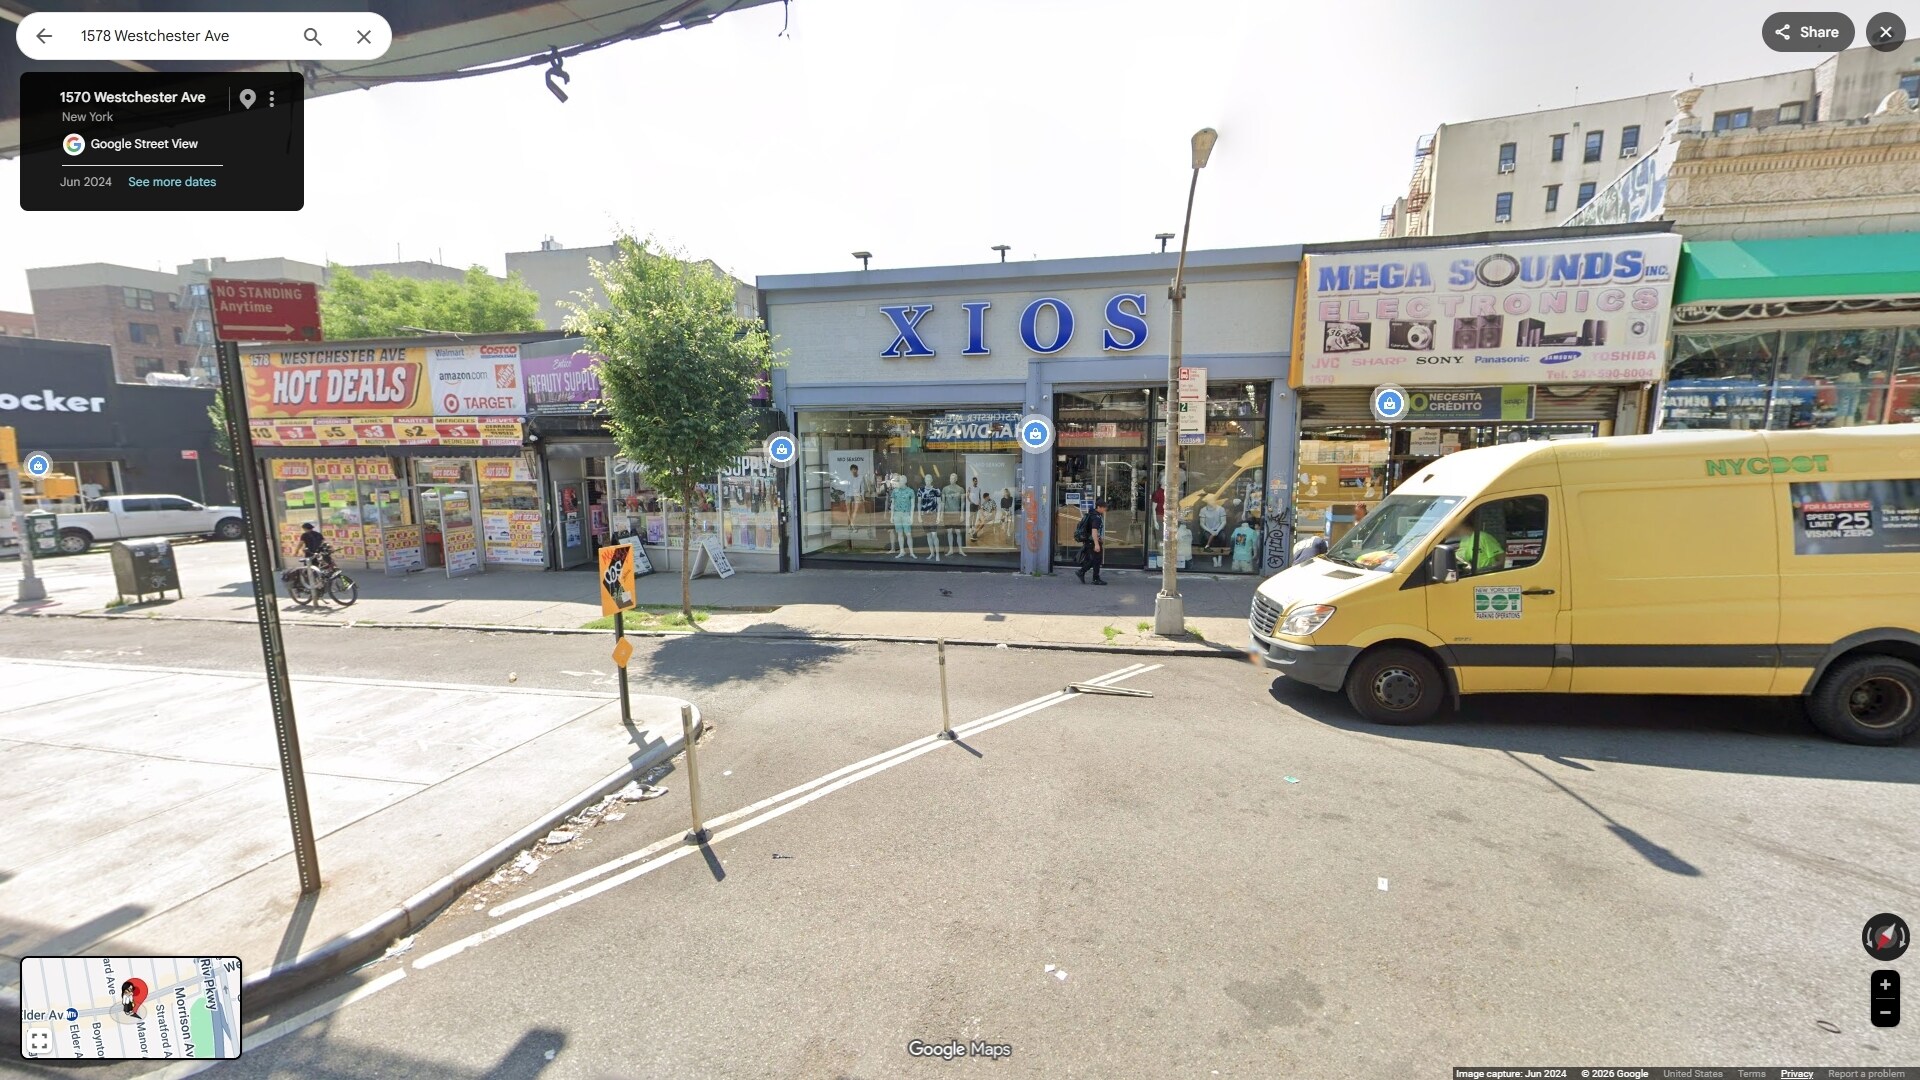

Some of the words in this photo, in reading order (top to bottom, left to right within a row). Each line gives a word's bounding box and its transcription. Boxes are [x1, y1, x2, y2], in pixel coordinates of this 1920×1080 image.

[1317, 261, 1433, 294] MEGA
[1448, 250, 1644, 288] SOUNDS
[216, 286, 235, 298] NO
[239, 287, 303, 300] STANDING
[220, 301, 273, 314] Anytime
[1318, 287, 1659, 321] ELECTRONICS
[879, 293, 1150, 358] XIOS
[434, 349, 465, 358] Walmart
[480, 345, 517, 354] COSTCO
[250, 354, 271, 367] 1578
[280, 350, 378, 365] WESTCHESTER
[379, 348, 406, 363] AVE
[1312, 357, 1341, 369] JVC
[1351, 356, 1408, 367] SHARP
[1416, 355, 1464, 366] SONY
[1474, 354, 1530, 364] Panasonic
[1544, 353, 1578, 362] SAMSUNG
[439, 371, 488, 382] amazon.com
[1546, 369, 1568, 379] Tel.
[273, 369, 322, 404] HOT
[326, 366, 407, 404] DEALS
[531, 373, 562, 394] BEAUTY
[564, 370, 599, 392] SUPPLY
[463, 397, 513, 409] TARGET
[1429, 392, 1482, 402] NECESITA
[1429, 401, 1482, 411] CRÉDITO
[405, 425, 428, 438] $2
[1804, 502, 1820, 510] FOR
[1853, 501, 1870, 509] NYC
[1806, 513, 1836, 521] SPEED
[1837, 512, 1870, 530] 25
[1805, 529, 1841, 538] VISION
[1843, 528, 1874, 538] ZERO
[1476, 594, 1520, 611] DOT
